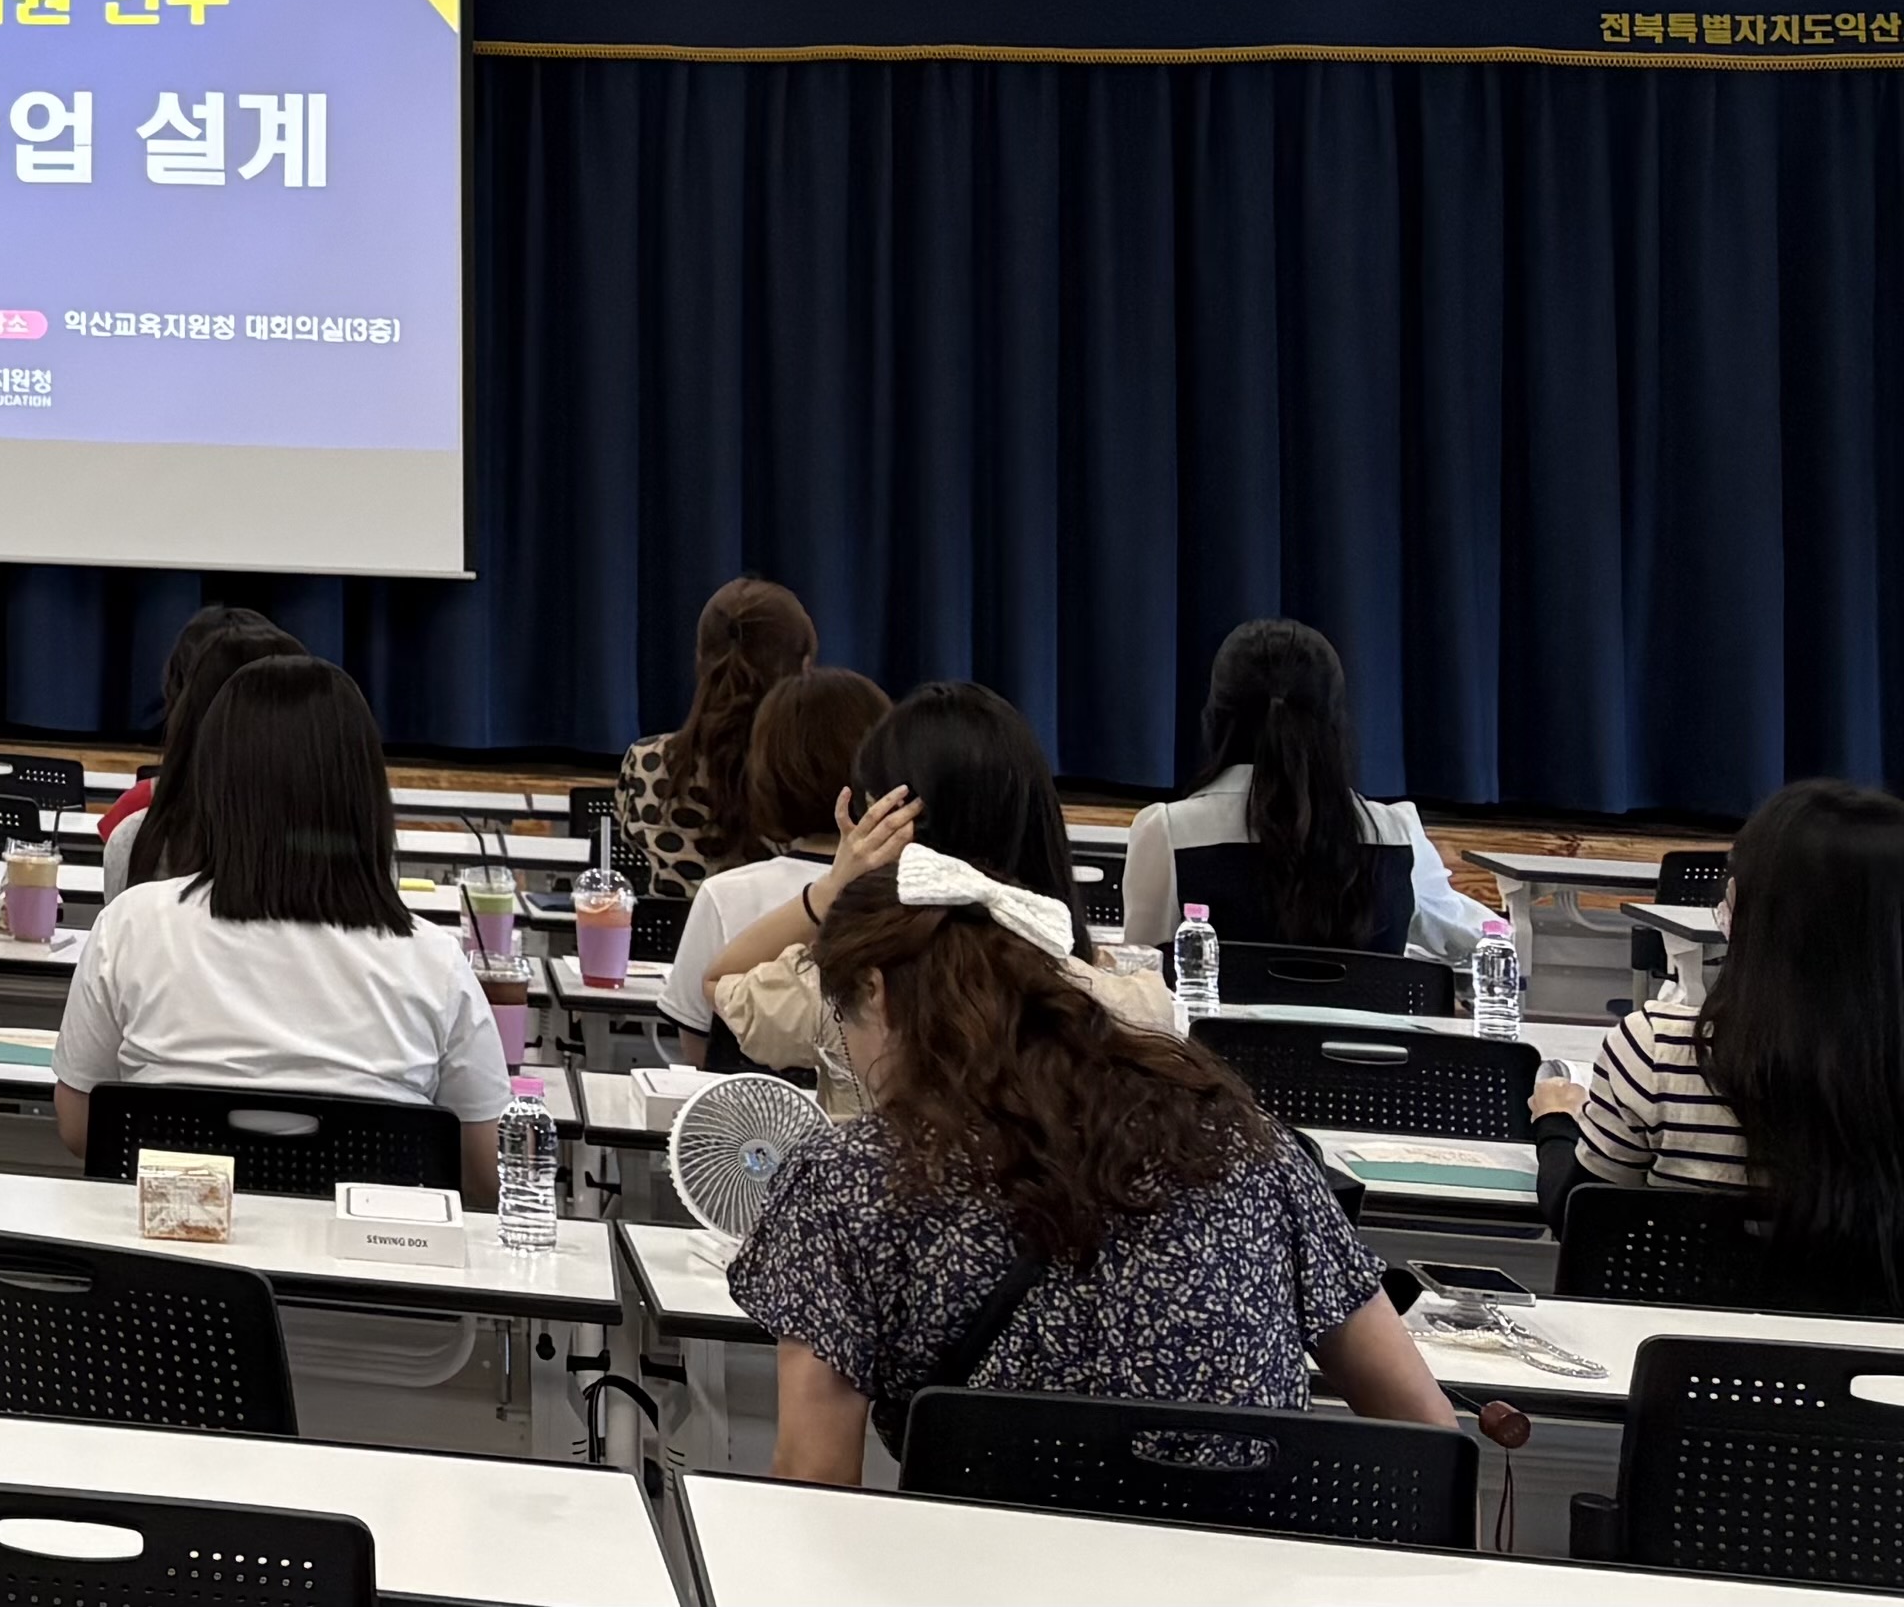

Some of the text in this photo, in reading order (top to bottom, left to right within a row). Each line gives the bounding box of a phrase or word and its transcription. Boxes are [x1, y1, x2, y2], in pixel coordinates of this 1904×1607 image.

[1599, 12, 1904, 44] 전북특별자치도익산
[134, 90, 328, 189] 설계
[64, 309, 401, 345] 익산교육지원청 대회의실(3층)
[366, 1234, 428, 1248] SEWING BOX
